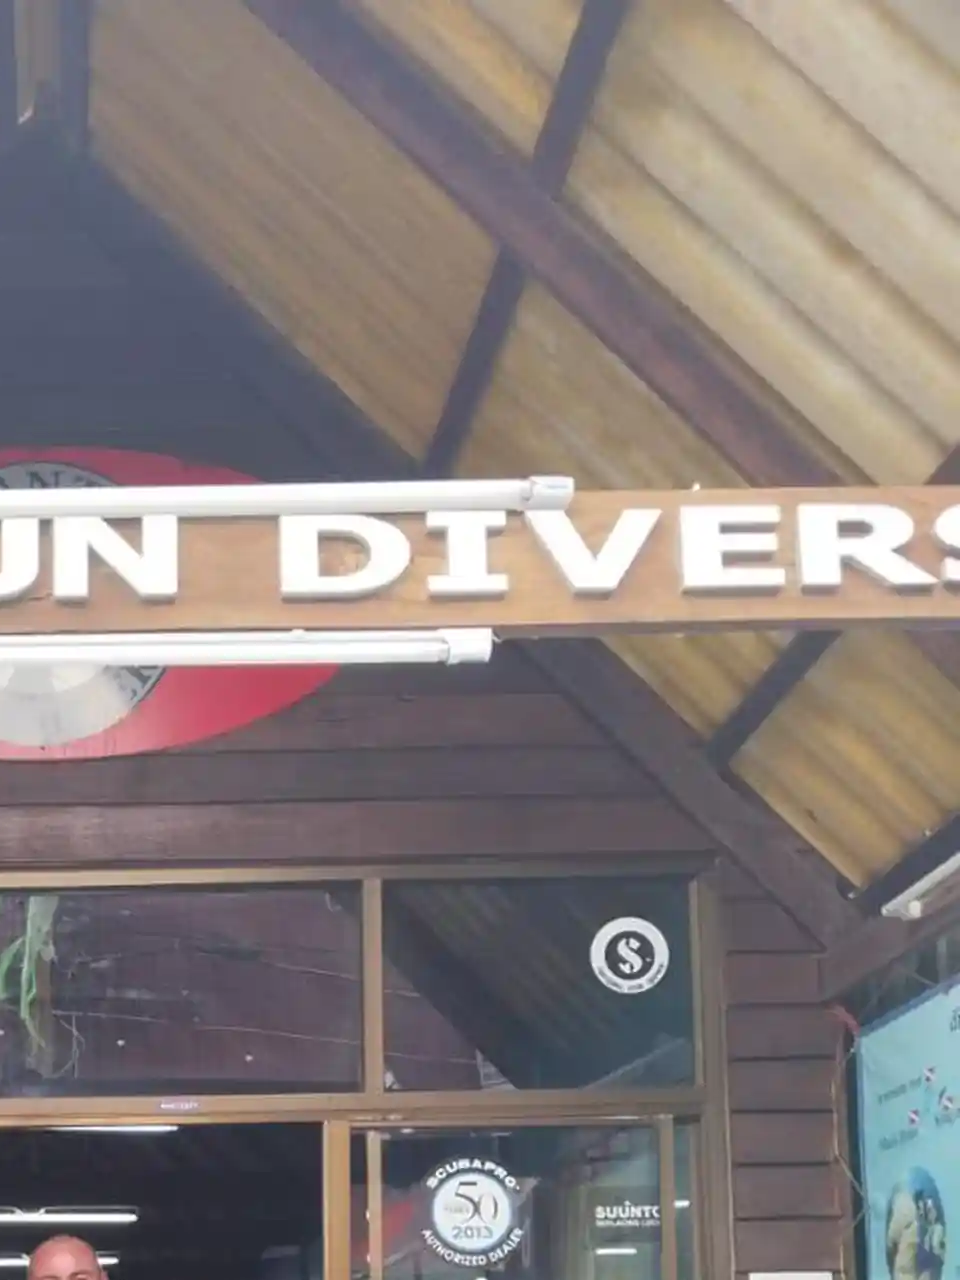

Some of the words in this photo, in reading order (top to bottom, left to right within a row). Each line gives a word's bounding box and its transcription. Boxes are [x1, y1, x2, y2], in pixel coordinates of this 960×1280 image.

[426, 1159, 518, 1190] SCUBAPRO
[455, 1181, 498, 1224] 50
[421, 1229, 487, 1265] AUTHORIZED
[488, 1228, 524, 1262] DEALER
